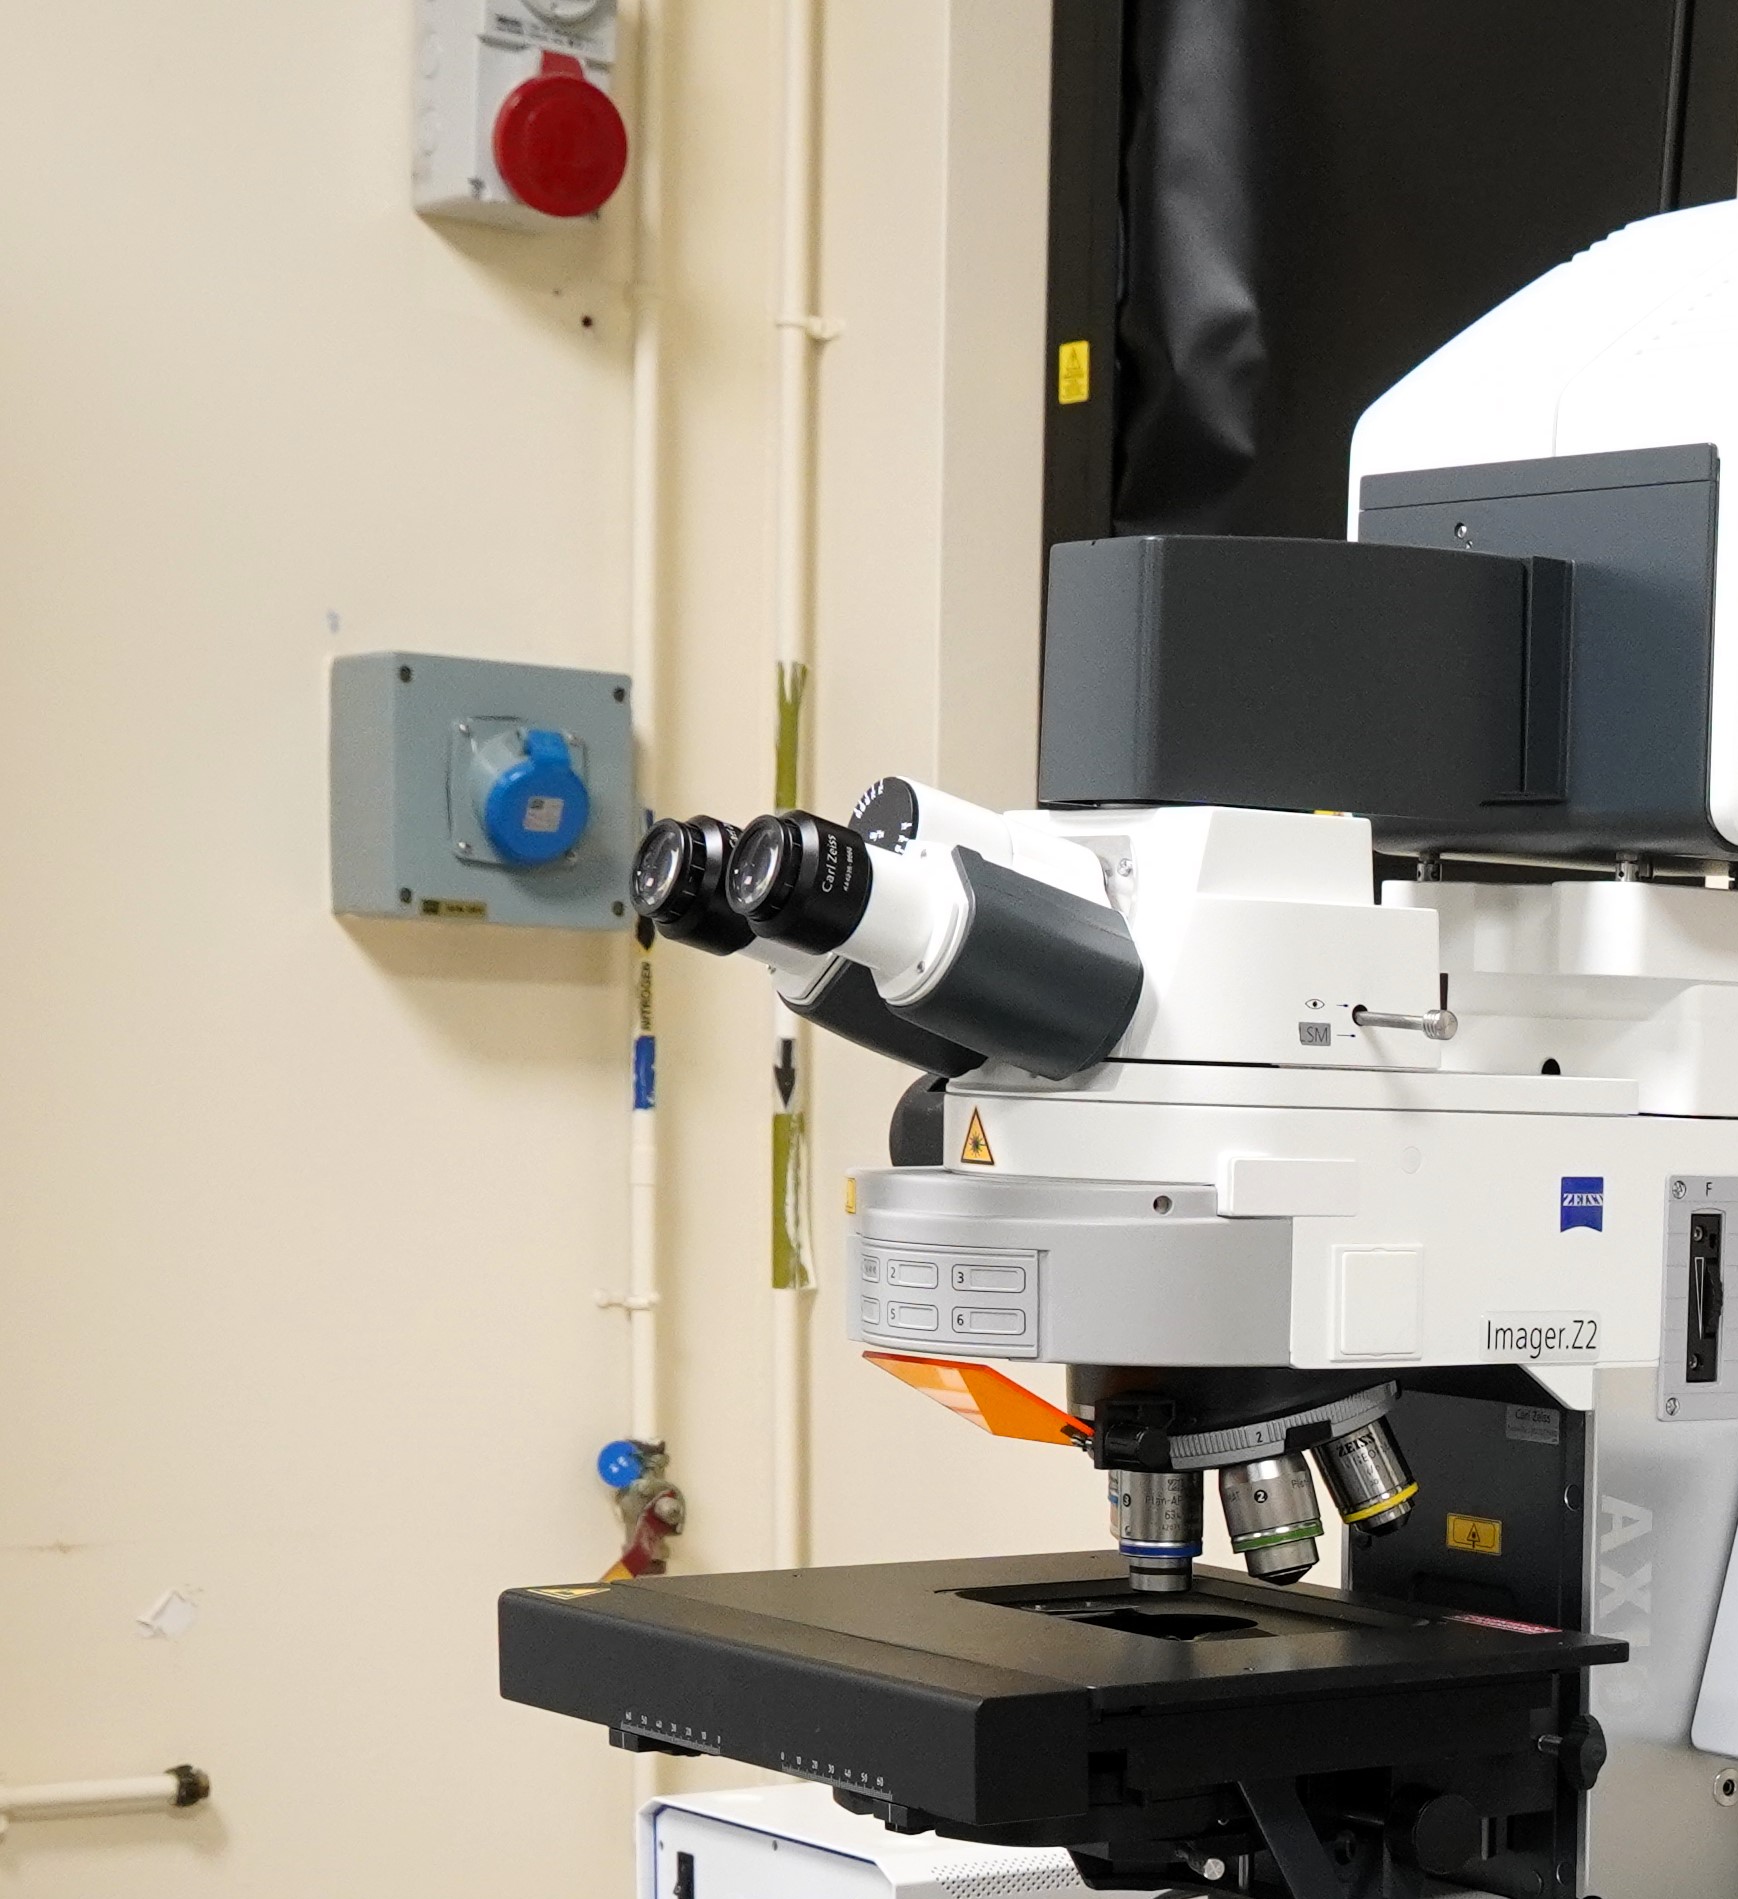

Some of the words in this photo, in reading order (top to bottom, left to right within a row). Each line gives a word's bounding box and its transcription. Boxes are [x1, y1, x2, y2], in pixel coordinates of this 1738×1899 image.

[827, 834, 838, 864] Zeiss
[822, 864, 836, 893] Carl
[640, 961, 652, 1031] NITROGEN
[1300, 1026, 1329, 1043] LSM
[1705, 1182, 1712, 1196] F
[1563, 1193, 1604, 1206] ZEISS
[890, 1267, 896, 1278] 2
[957, 1272, 964, 1283] 3
[890, 1308, 896, 1320] 5
[957, 1314, 964, 1325] 6
[1487, 1320, 1598, 1359] Imager.Z2
[1514, 1411, 1530, 1420] Carl
[1532, 1411, 1552, 1424] Zeiss
[1255, 1430, 1263, 1443] 2
[1335, 1433, 1376, 1457] ZEISS
[860, 1772, 868, 1782] 50
